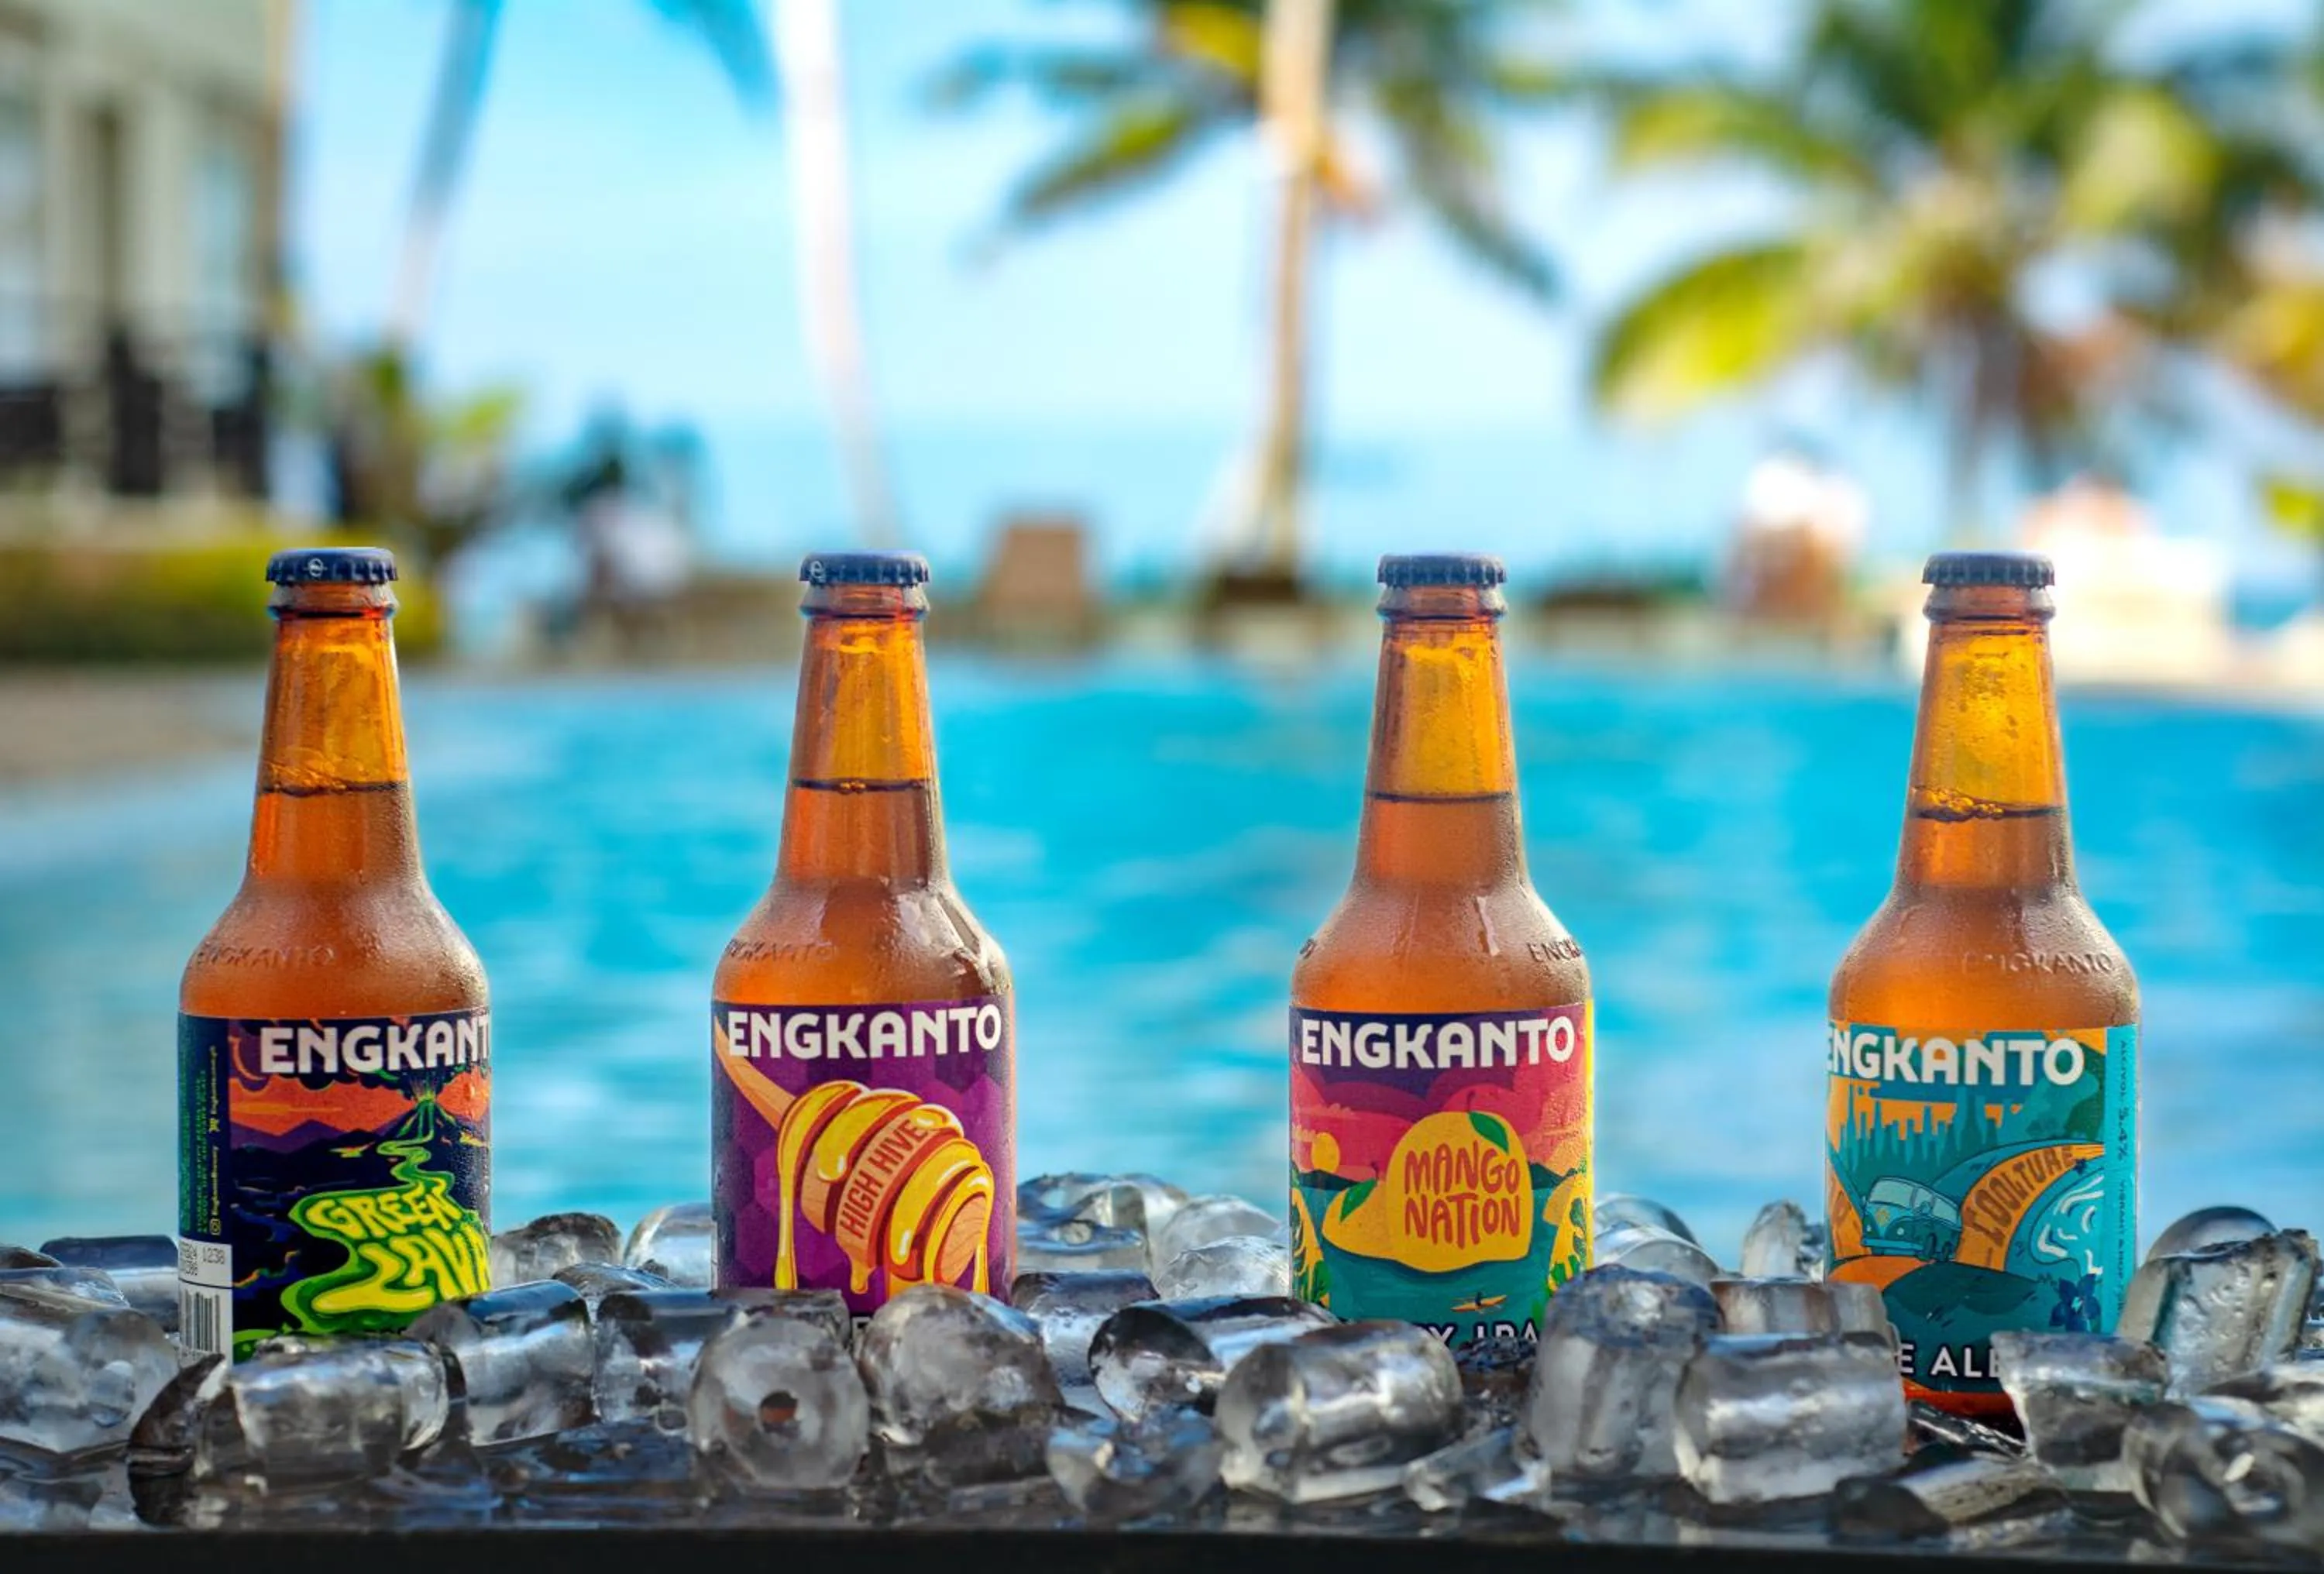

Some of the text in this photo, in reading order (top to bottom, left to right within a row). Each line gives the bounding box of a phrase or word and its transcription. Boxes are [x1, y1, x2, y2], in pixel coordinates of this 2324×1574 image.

[727, 1004, 1002, 1059] ENGKANTO
[1301, 1016, 1576, 1069] ENGKANTO
[839, 1119, 929, 1239] HIGH HIVE
[1404, 1140, 1521, 1194] MANGO
[306, 1177, 463, 1239] GREEN
[1404, 1192, 1521, 1250] NATION
